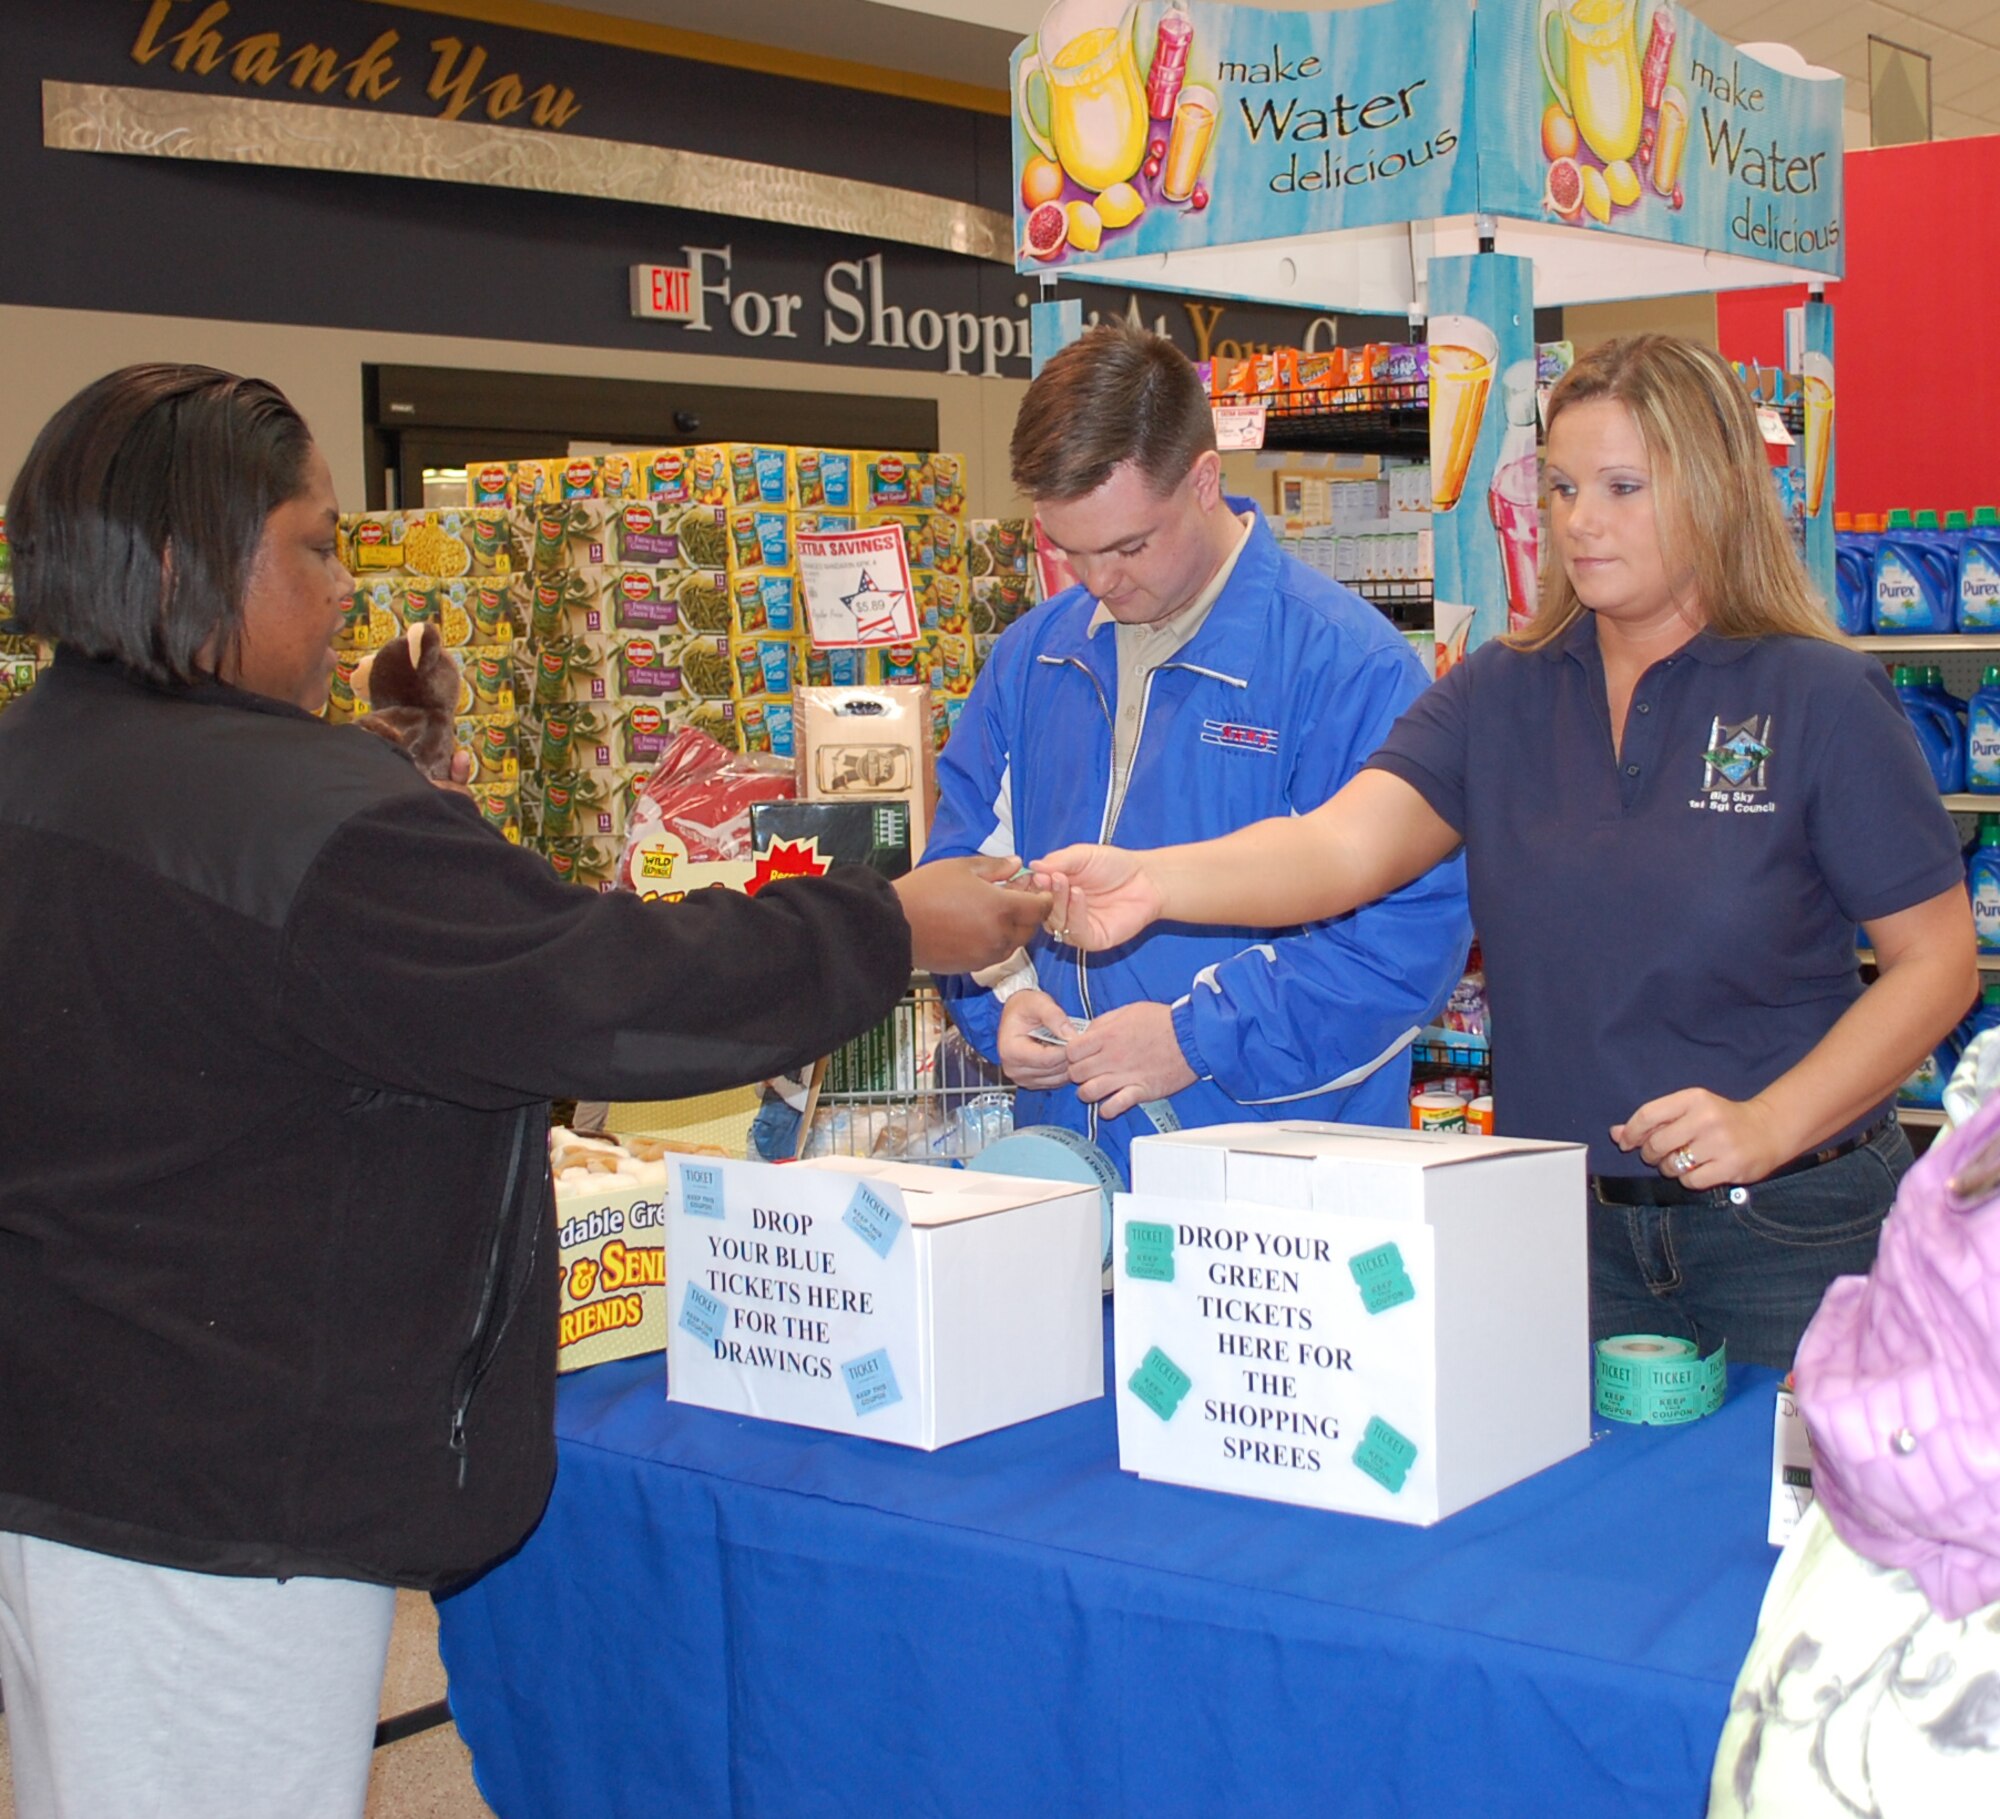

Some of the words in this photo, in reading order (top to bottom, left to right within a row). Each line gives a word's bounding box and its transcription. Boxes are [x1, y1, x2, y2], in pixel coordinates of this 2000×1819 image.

[130, 0, 401, 102] Thank
[427, 36, 581, 128] You
[1218, 44, 1322, 84] make
[1692, 58, 1765, 113] make
[1239, 79, 1426, 144] Water
[1269, 127, 1458, 194] delicious
[1701, 106, 1826, 195] Water
[1731, 197, 1840, 255] delicious
[651, 268, 691, 313] EXIT
[681, 245, 801, 338] For
[824, 253, 1031, 379] Shoppi
[797, 542, 827, 557] EXTRA
[829, 536, 895, 557] SAVINGS
[1879, 582, 1917, 598] Purex
[1963, 580, 1999, 597] Purex
[856, 600, 885, 613] $5.89
[1972, 739, 2000, 756] Pure
[1709, 801, 1729, 813] Sgt
[1734, 803, 1775, 814] Council
[1710, 791, 1729, 802] Big
[1732, 791, 1754, 804] Sky
[1975, 901, 2000, 918] Pur
[686, 1169, 713, 1184] TICKET
[752, 1207, 813, 1236] DROP
[862, 1190, 890, 1222] TICKET
[558, 1206, 625, 1249] dable
[629, 1200, 665, 1229] Gre
[1132, 1229, 1162, 1244] TICKET
[707, 1236, 769, 1265] YOUR
[776, 1246, 836, 1275] BLUE
[1178, 1224, 1249, 1251] DROP
[1255, 1232, 1331, 1262] YOUR
[1208, 1262, 1300, 1294] GREEN
[1356, 1252, 1389, 1275] TICKET
[692, 1289, 718, 1315] TICKET
[706, 1269, 800, 1305] TICKETS
[808, 1285, 873, 1315] HERE
[558, 1292, 643, 1350] RIENDS
[734, 1308, 777, 1335] FOR
[783, 1316, 830, 1344] THE
[1197, 1295, 1313, 1331] TICKETS
[714, 1338, 832, 1379] DRAWINGS
[1218, 1332, 1290, 1364] HERE
[1299, 1343, 1353, 1371] FOR
[848, 1358, 879, 1380] TICKET
[1152, 1354, 1180, 1386] TICKET
[1243, 1369, 1297, 1399] THE
[1601, 1362, 1631, 1382] TICKET
[1653, 1370, 1691, 1385] TICKET
[1599, 1401, 1632, 1416] COUPON
[1604, 1391, 1625, 1402] KEEP
[1659, 1397, 1686, 1406] KEEP
[1204, 1399, 1340, 1440] SHOPPING
[1652, 1408, 1692, 1419] COUPON
[1223, 1436, 1322, 1472] SPREES
[1373, 1423, 1405, 1455] TICKET
